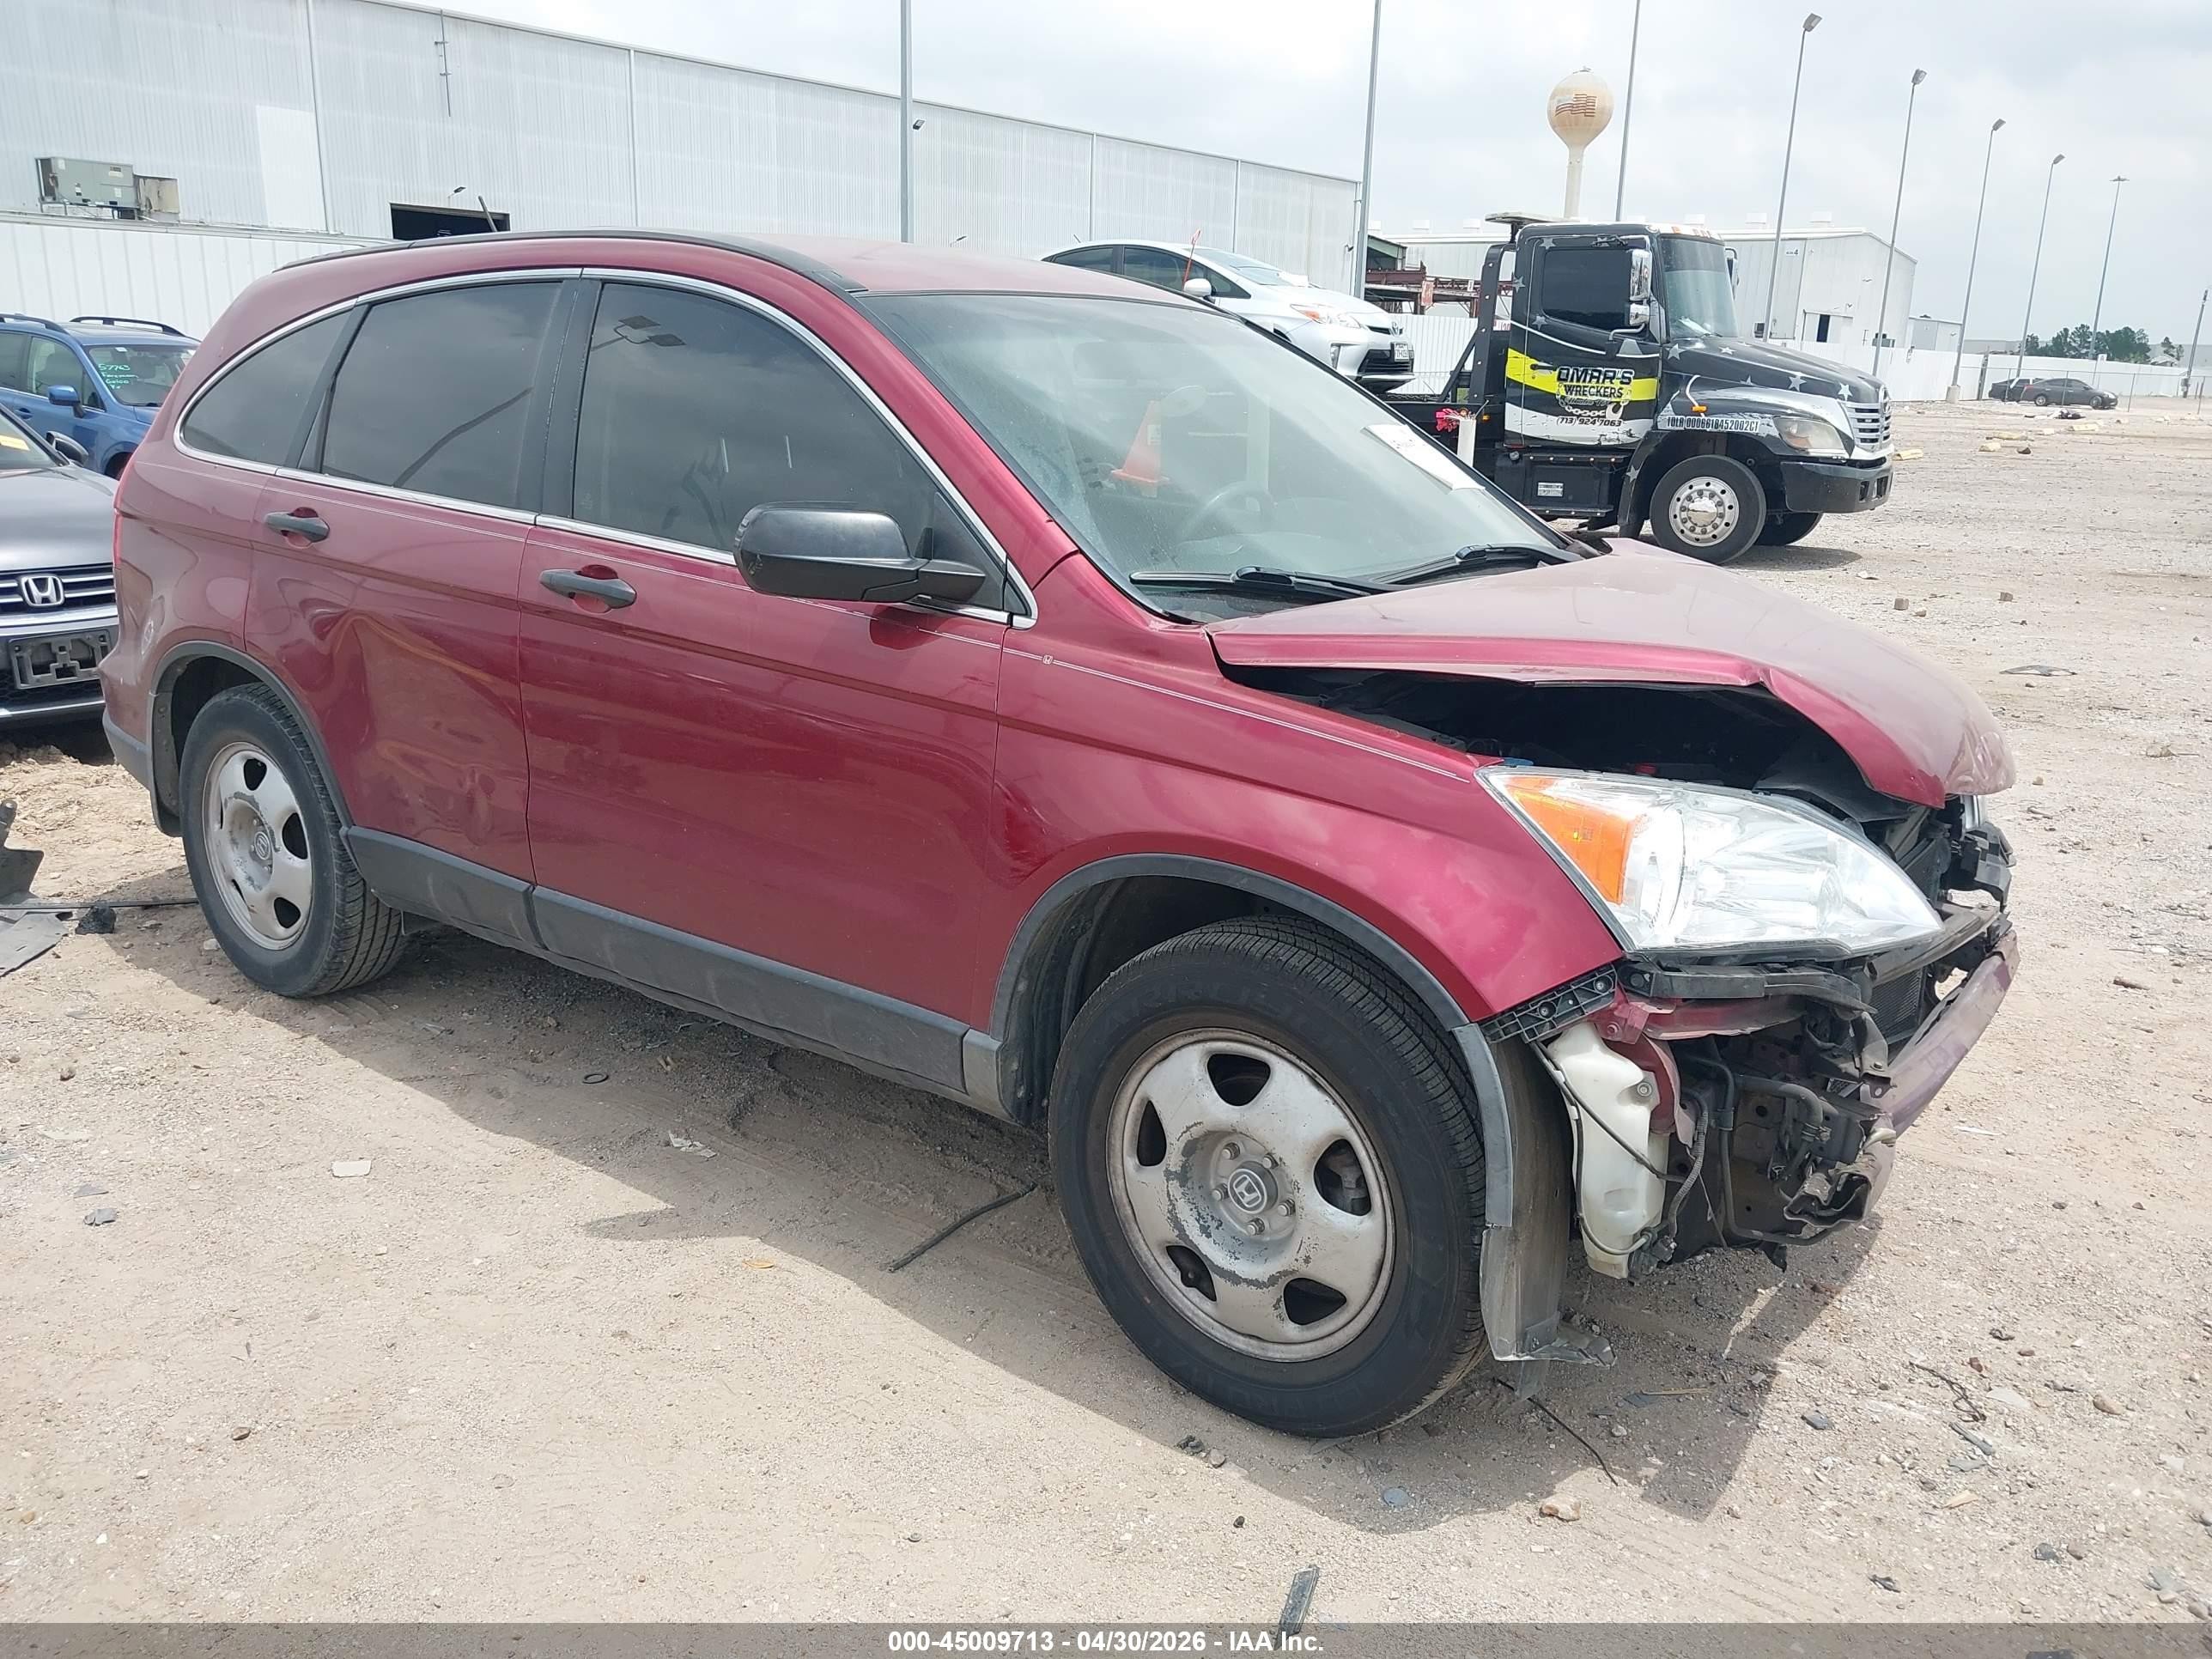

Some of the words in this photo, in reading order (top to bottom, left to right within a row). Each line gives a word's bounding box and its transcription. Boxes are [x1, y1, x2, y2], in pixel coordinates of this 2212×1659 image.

[1556, 366, 1634, 386] OMAR'S
[1564, 383, 1624, 398] WRECKERS
[1556, 416, 1577, 426] (713)
